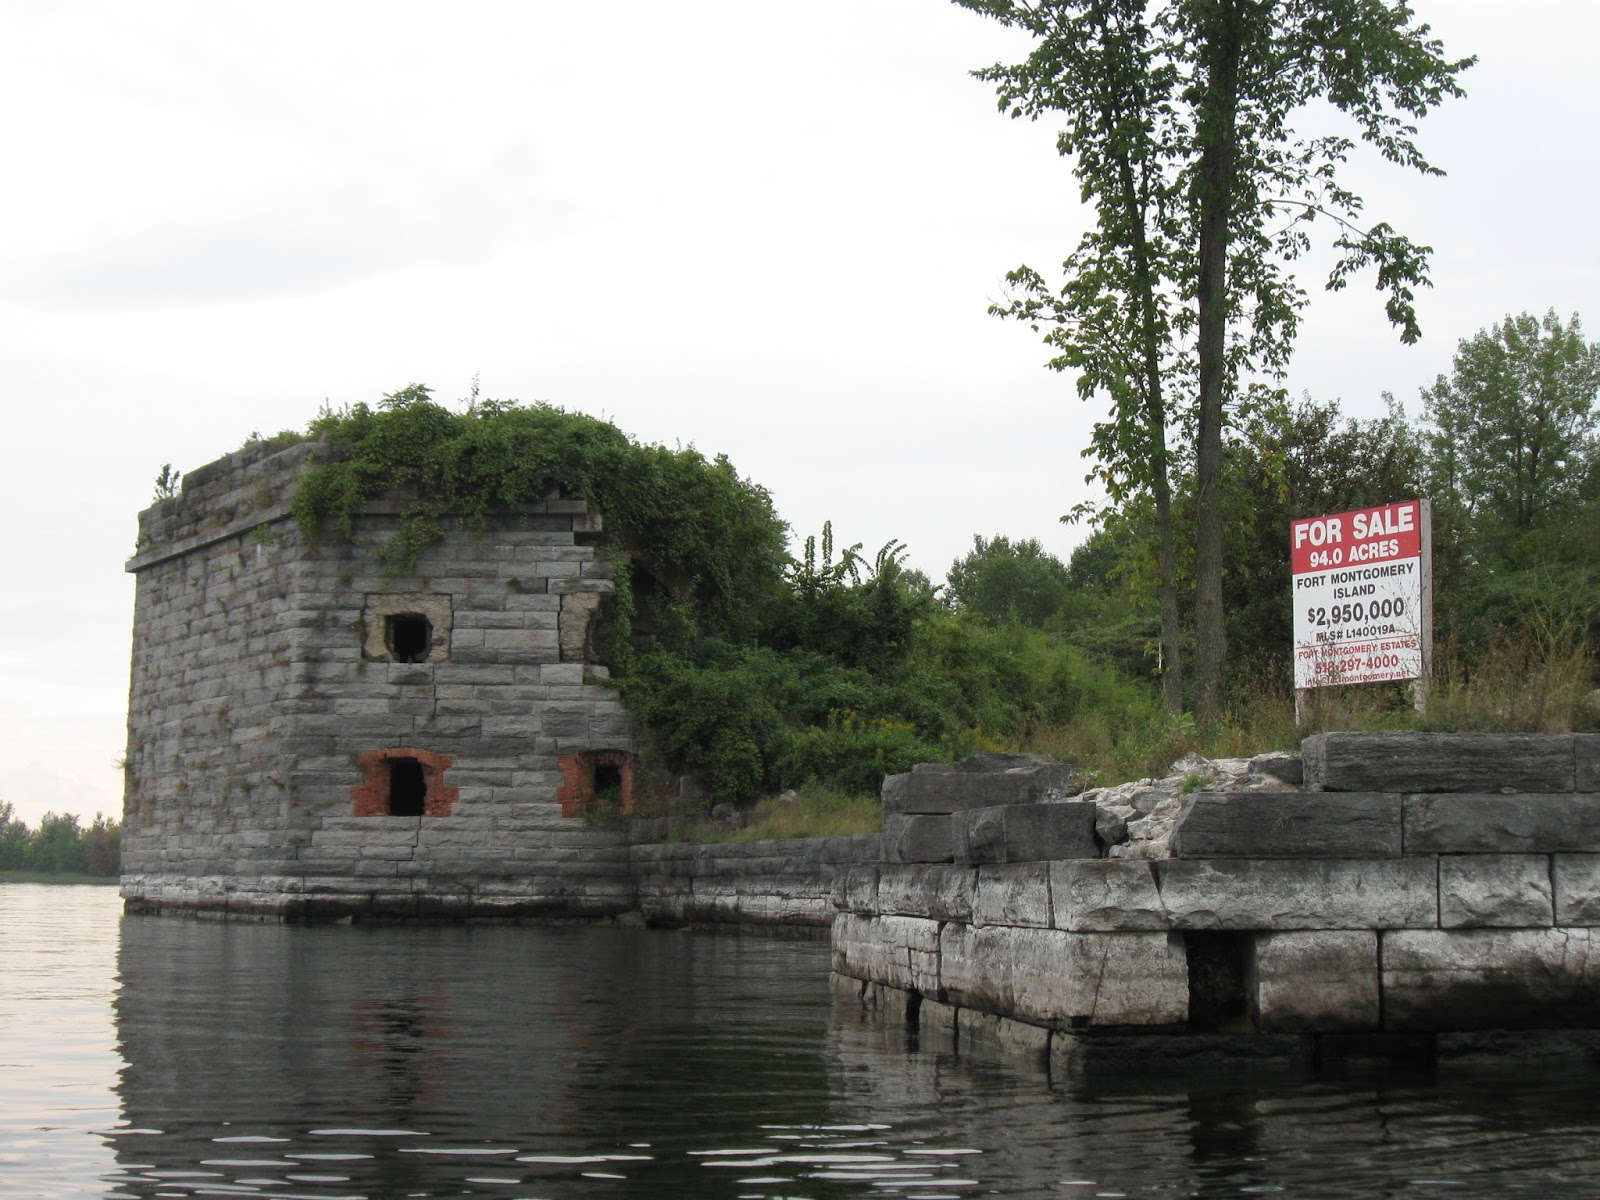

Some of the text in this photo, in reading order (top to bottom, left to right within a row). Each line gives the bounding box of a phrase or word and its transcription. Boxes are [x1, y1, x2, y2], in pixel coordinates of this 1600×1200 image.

[1295, 505, 1414, 549] FOR SALE
[1310, 539, 1399, 568] 94.0 ACRES
[1297, 563, 1414, 589] FORT MONTGOMERY
[1333, 584, 1376, 599] ISLAND
[1307, 597, 1405, 629] $2,950,000
[1316, 624, 1396, 642] MLS# L140019A
[1298, 639, 1417, 660] FORT MONTGOMERY ESTATES
[1315, 654, 1399, 675] 518-297-4000
